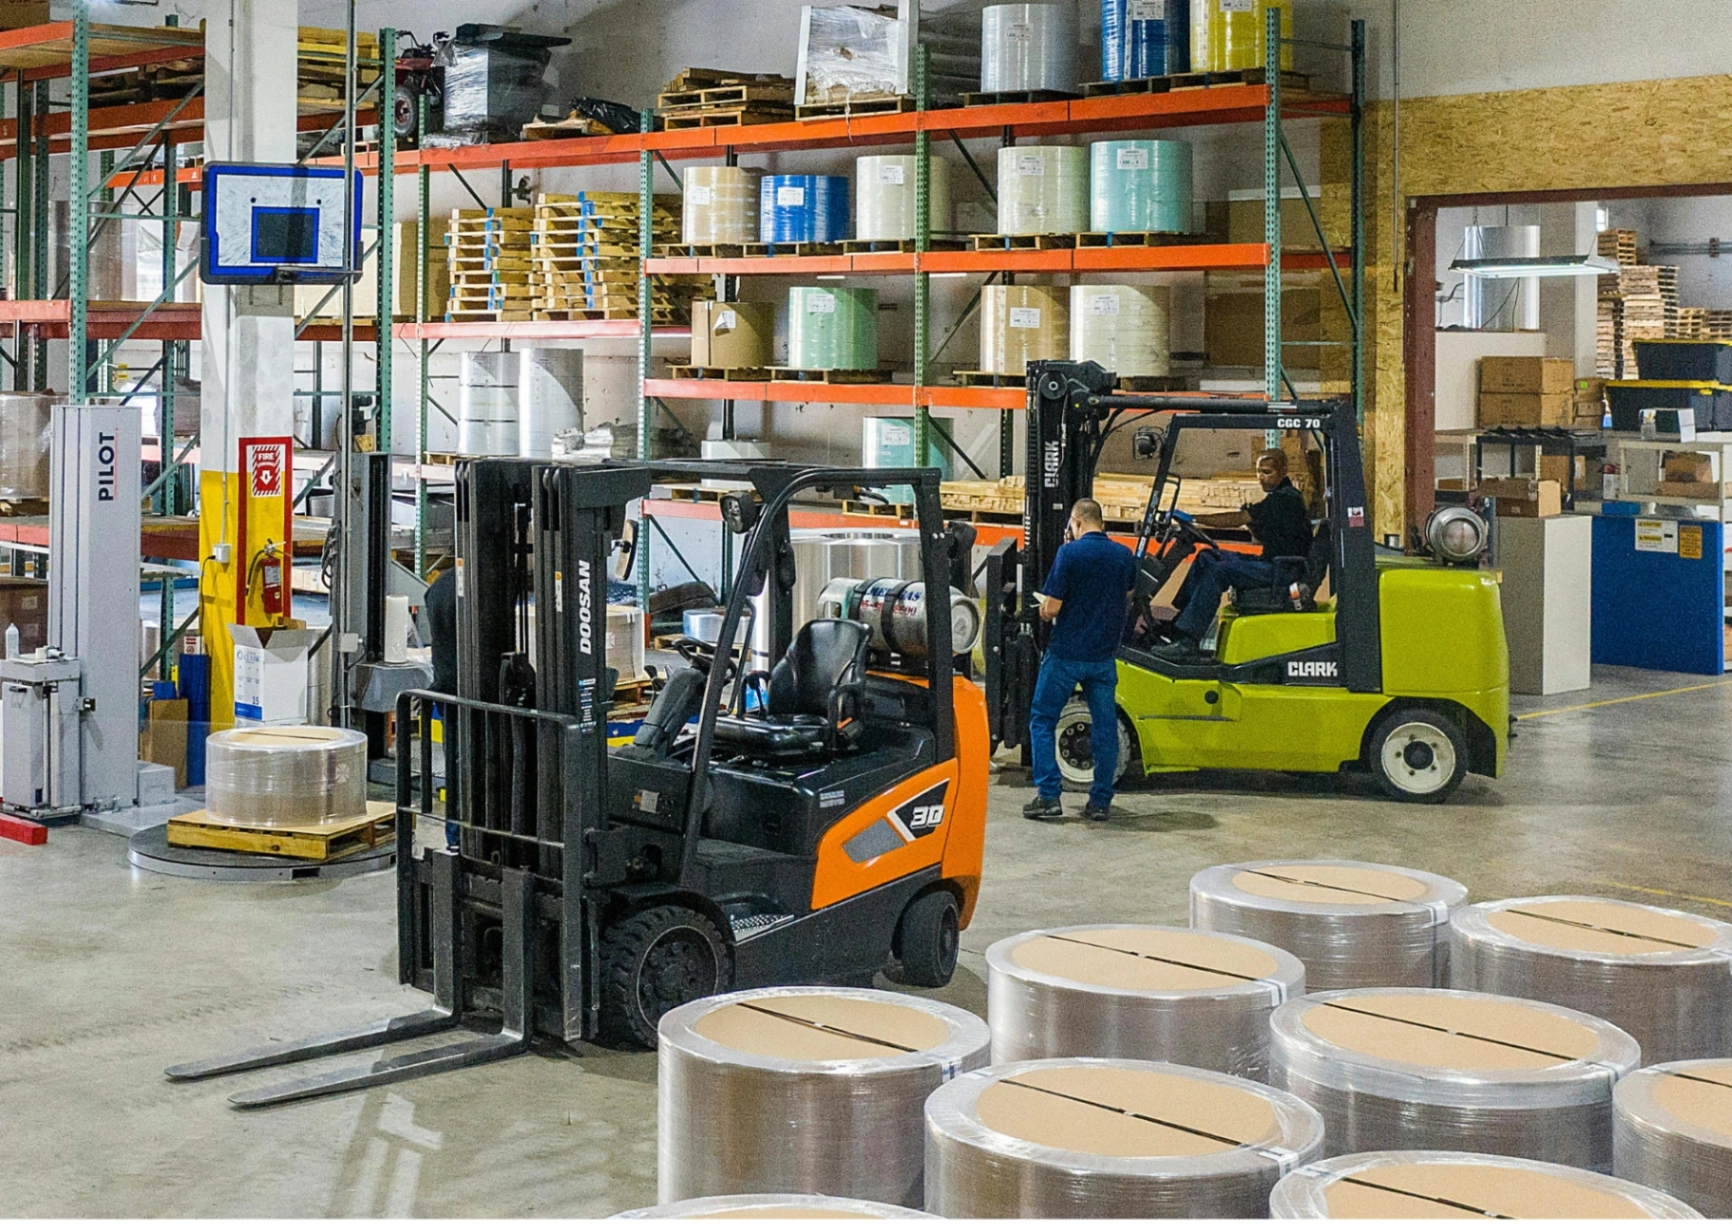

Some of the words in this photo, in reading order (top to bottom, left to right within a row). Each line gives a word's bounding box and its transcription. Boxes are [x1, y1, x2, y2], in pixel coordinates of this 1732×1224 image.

[1277, 418, 1301, 428] CGC
[1304, 418, 1320, 428] 70
[98, 432, 115, 502] PILOT
[257, 452, 276, 461] FIRE
[1044, 441, 1059, 488] CLARK
[578, 559, 592, 655] DOOSAN
[1287, 661, 1338, 677] CLARK
[909, 804, 945, 829] 30
